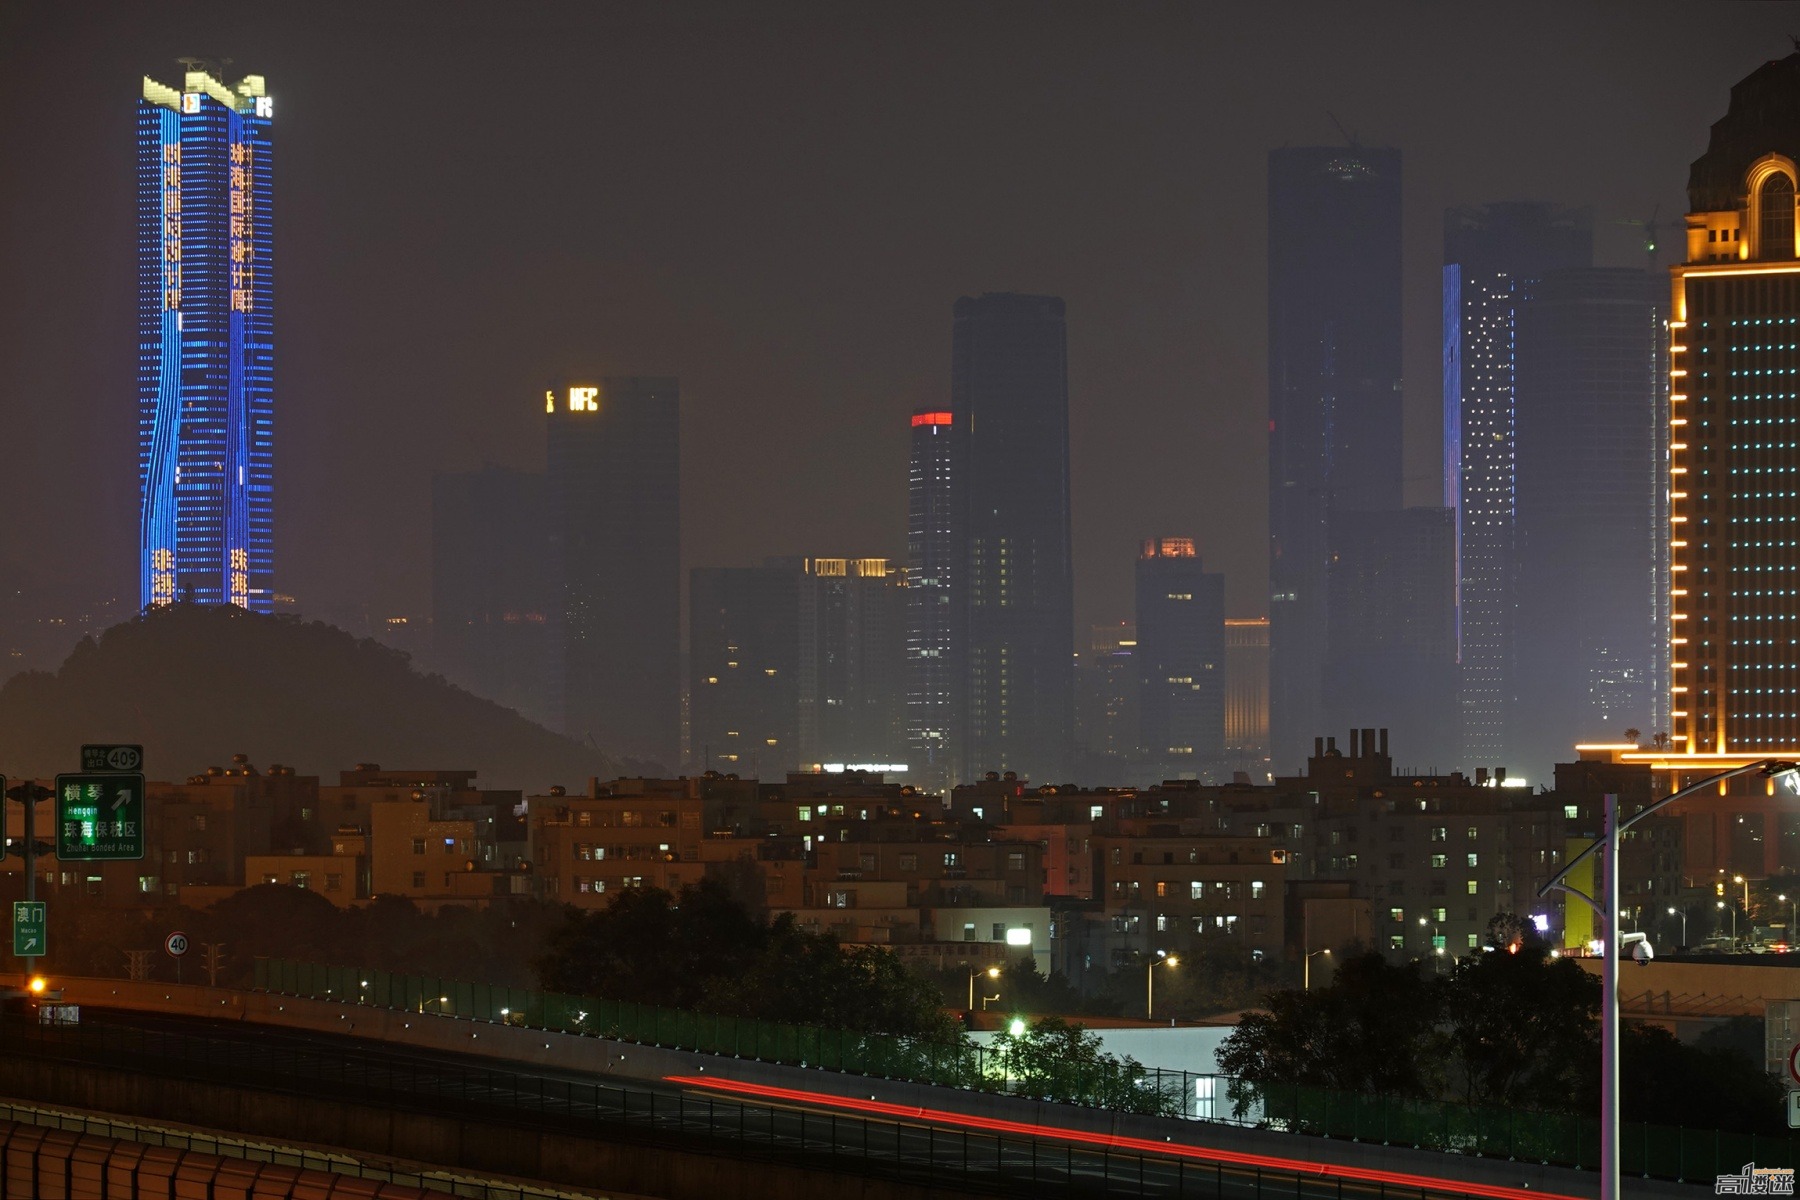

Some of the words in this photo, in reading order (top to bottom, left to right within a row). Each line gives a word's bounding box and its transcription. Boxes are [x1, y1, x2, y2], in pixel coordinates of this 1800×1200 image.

[87, 758, 104, 768] 出口
[110, 751, 137, 766] 409
[64, 783, 104, 802] 横琴
[67, 806, 98, 817] Hengqin
[64, 820, 136, 838] 珠海保税区
[66, 843, 89, 852] Zhuhai
[91, 843, 116, 852] Bonded
[117, 843, 135, 852] Area
[17, 907, 43, 923] 澳门
[170, 938, 186, 951] 40
